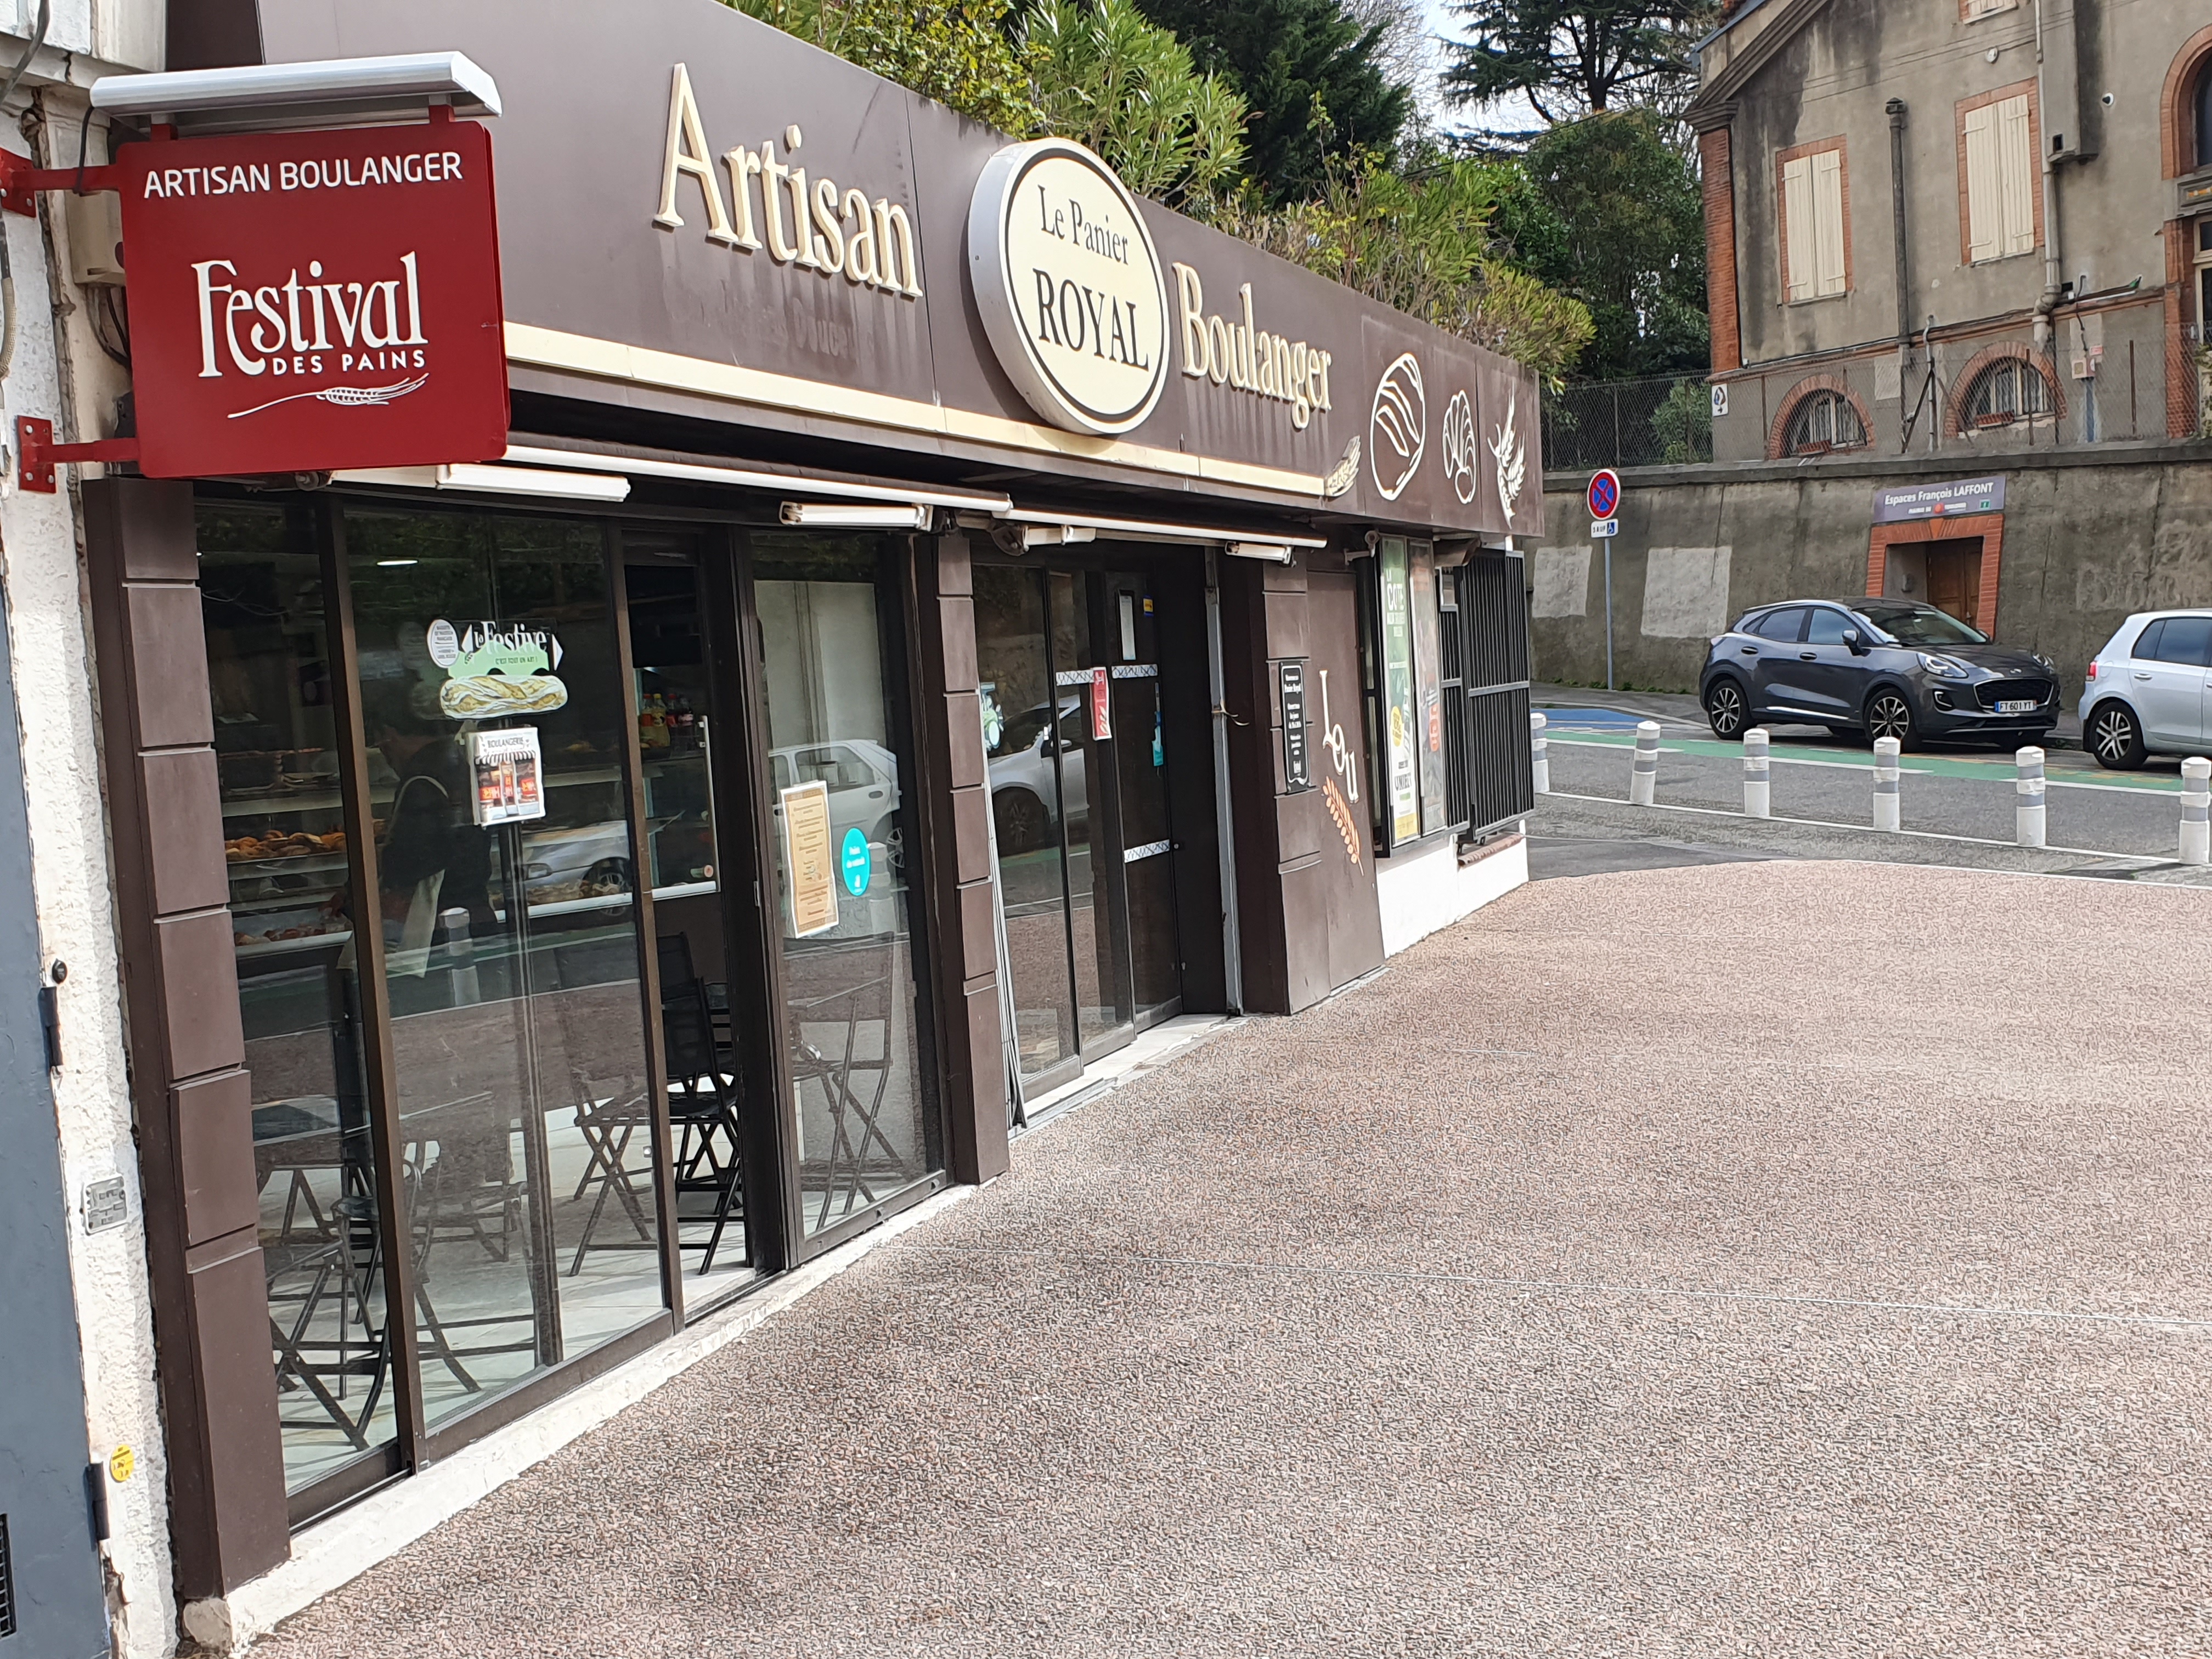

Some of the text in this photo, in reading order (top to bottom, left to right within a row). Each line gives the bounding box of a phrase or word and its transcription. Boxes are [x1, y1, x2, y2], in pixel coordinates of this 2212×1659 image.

[144, 151, 463, 199] ARTISAN BOULANGER
[654, 63, 923, 298] Artisan
[1037, 184, 1128, 266] Le Panier
[191, 251, 428, 378] Festival
[1032, 268, 1149, 372] ROYAL
[1172, 262, 1332, 429] Boulanger
[273, 349, 426, 376] DES PAINS
[1593, 525, 1606, 533] SAUF
[1884, 482, 1994, 507] Espaces François LAFFONT
